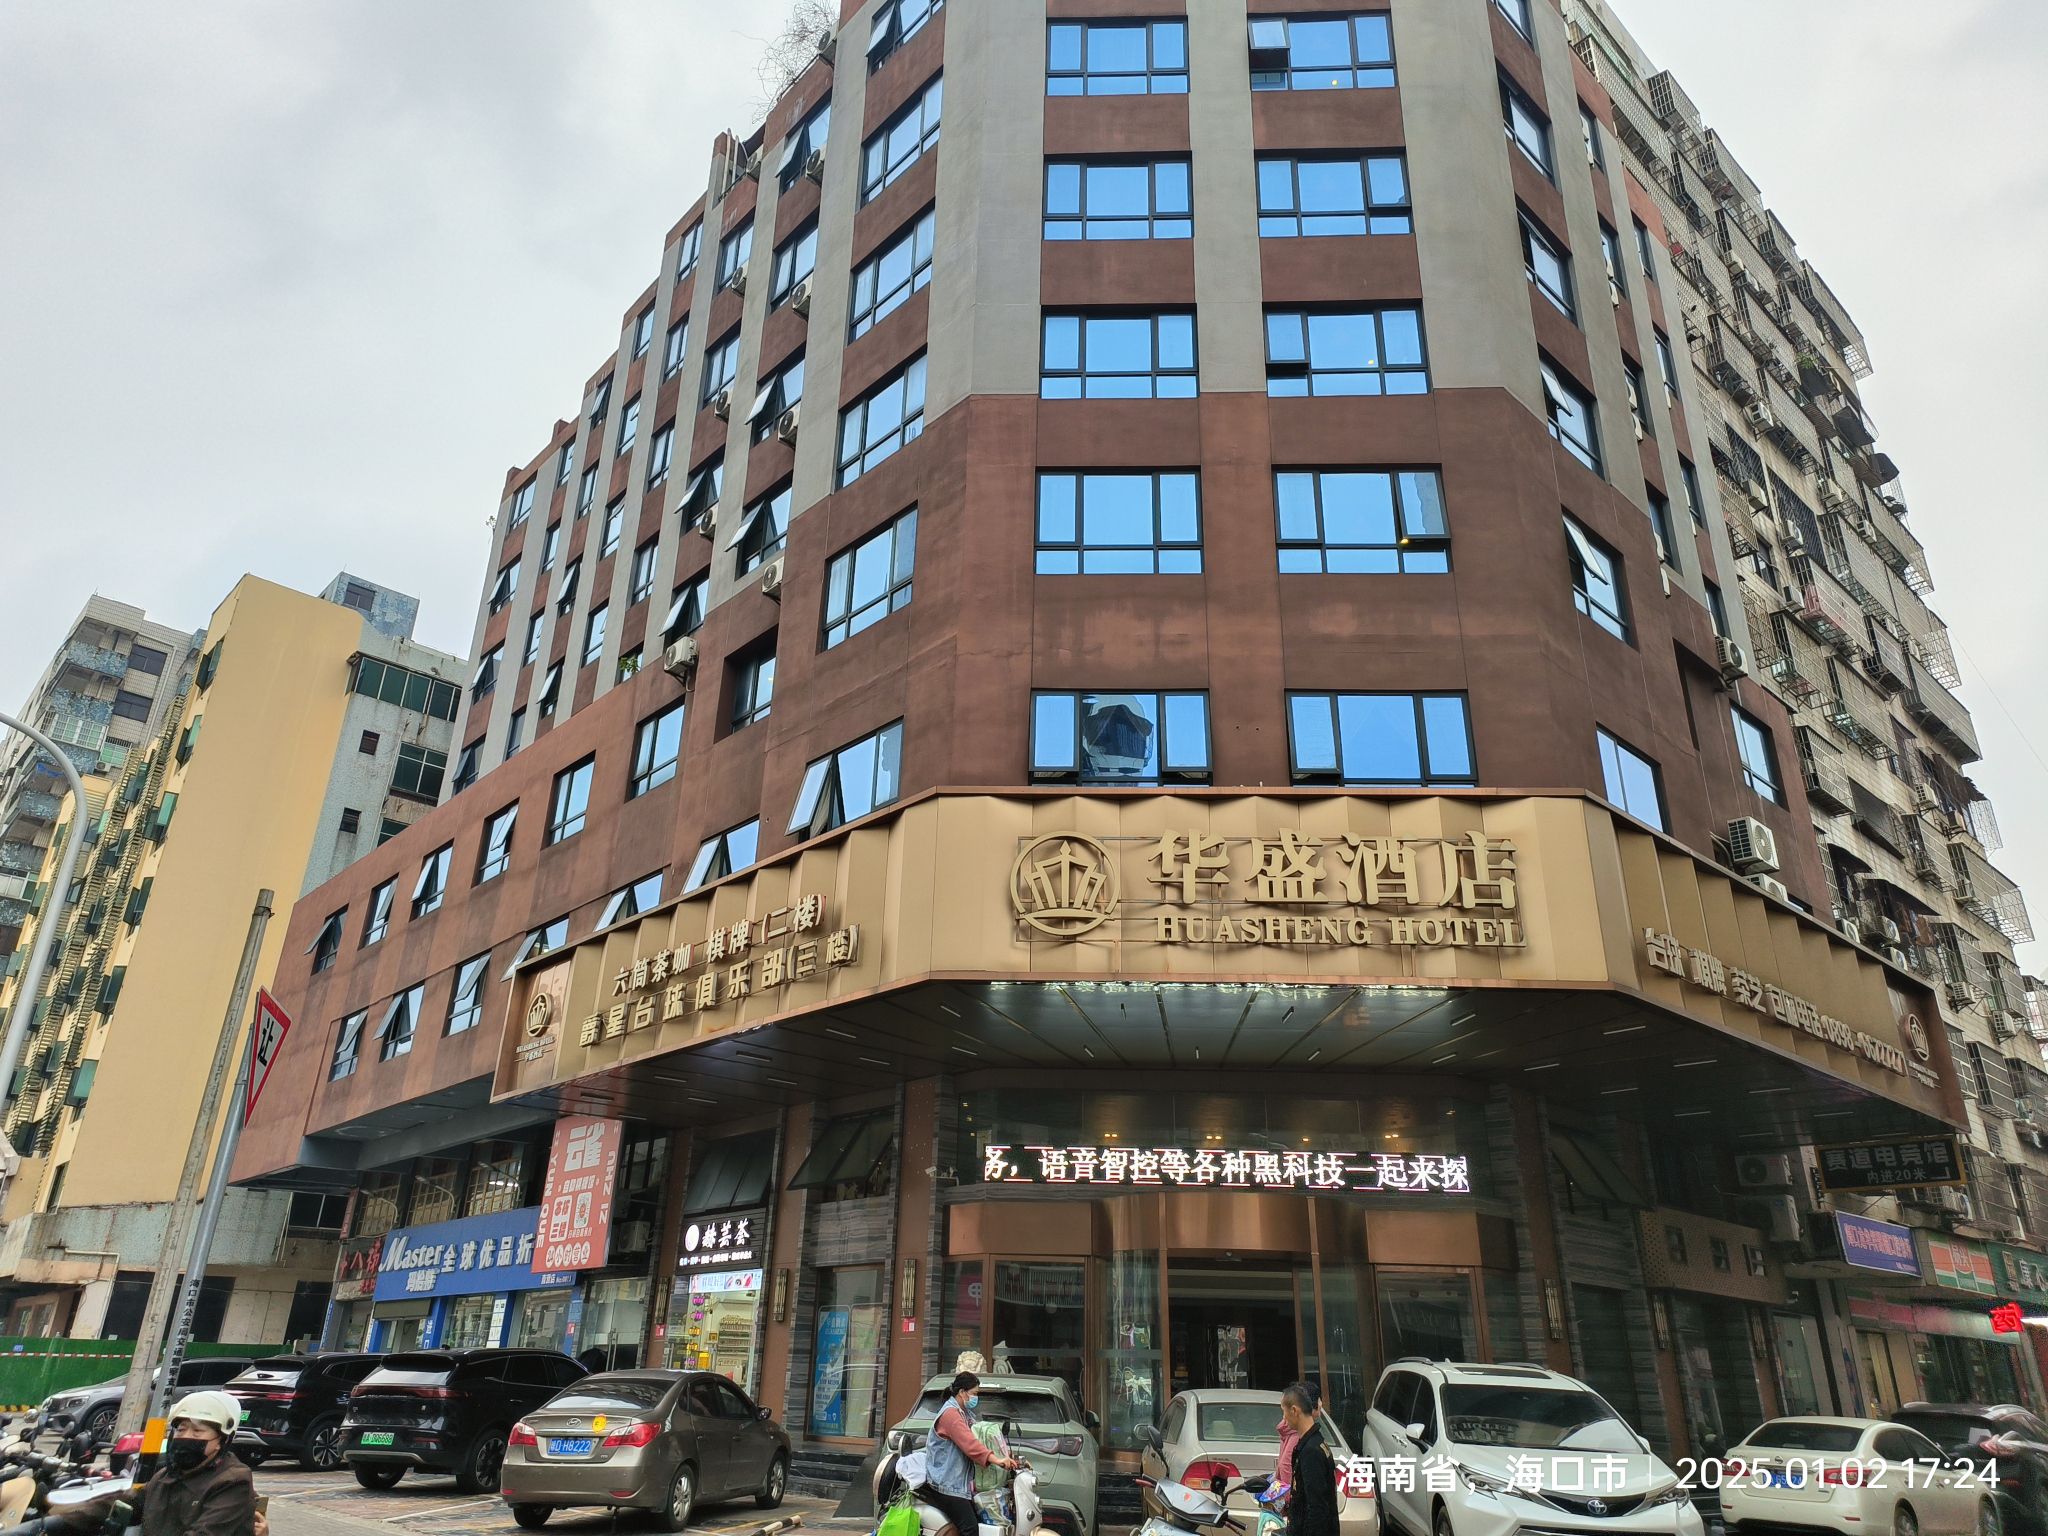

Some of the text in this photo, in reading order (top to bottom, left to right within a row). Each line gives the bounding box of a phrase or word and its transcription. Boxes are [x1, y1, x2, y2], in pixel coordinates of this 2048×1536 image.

[1146, 827, 1517, 909] 华盛酒店
[612, 894, 827, 996] 六筒茶咖 棋牌 (二楼)
[1155, 915, 1528, 949] HUASHENG HOTEL
[1644, 928, 1686, 978] 台球
[1689, 948, 1727, 996] 棋牌
[1731, 967, 1767, 1013] 茶艺
[1826, 1142, 1949, 1171] 赛道电竞馆
[1867, 1168, 1927, 1184] 内进20米
[378, 1236, 444, 1272] Master
